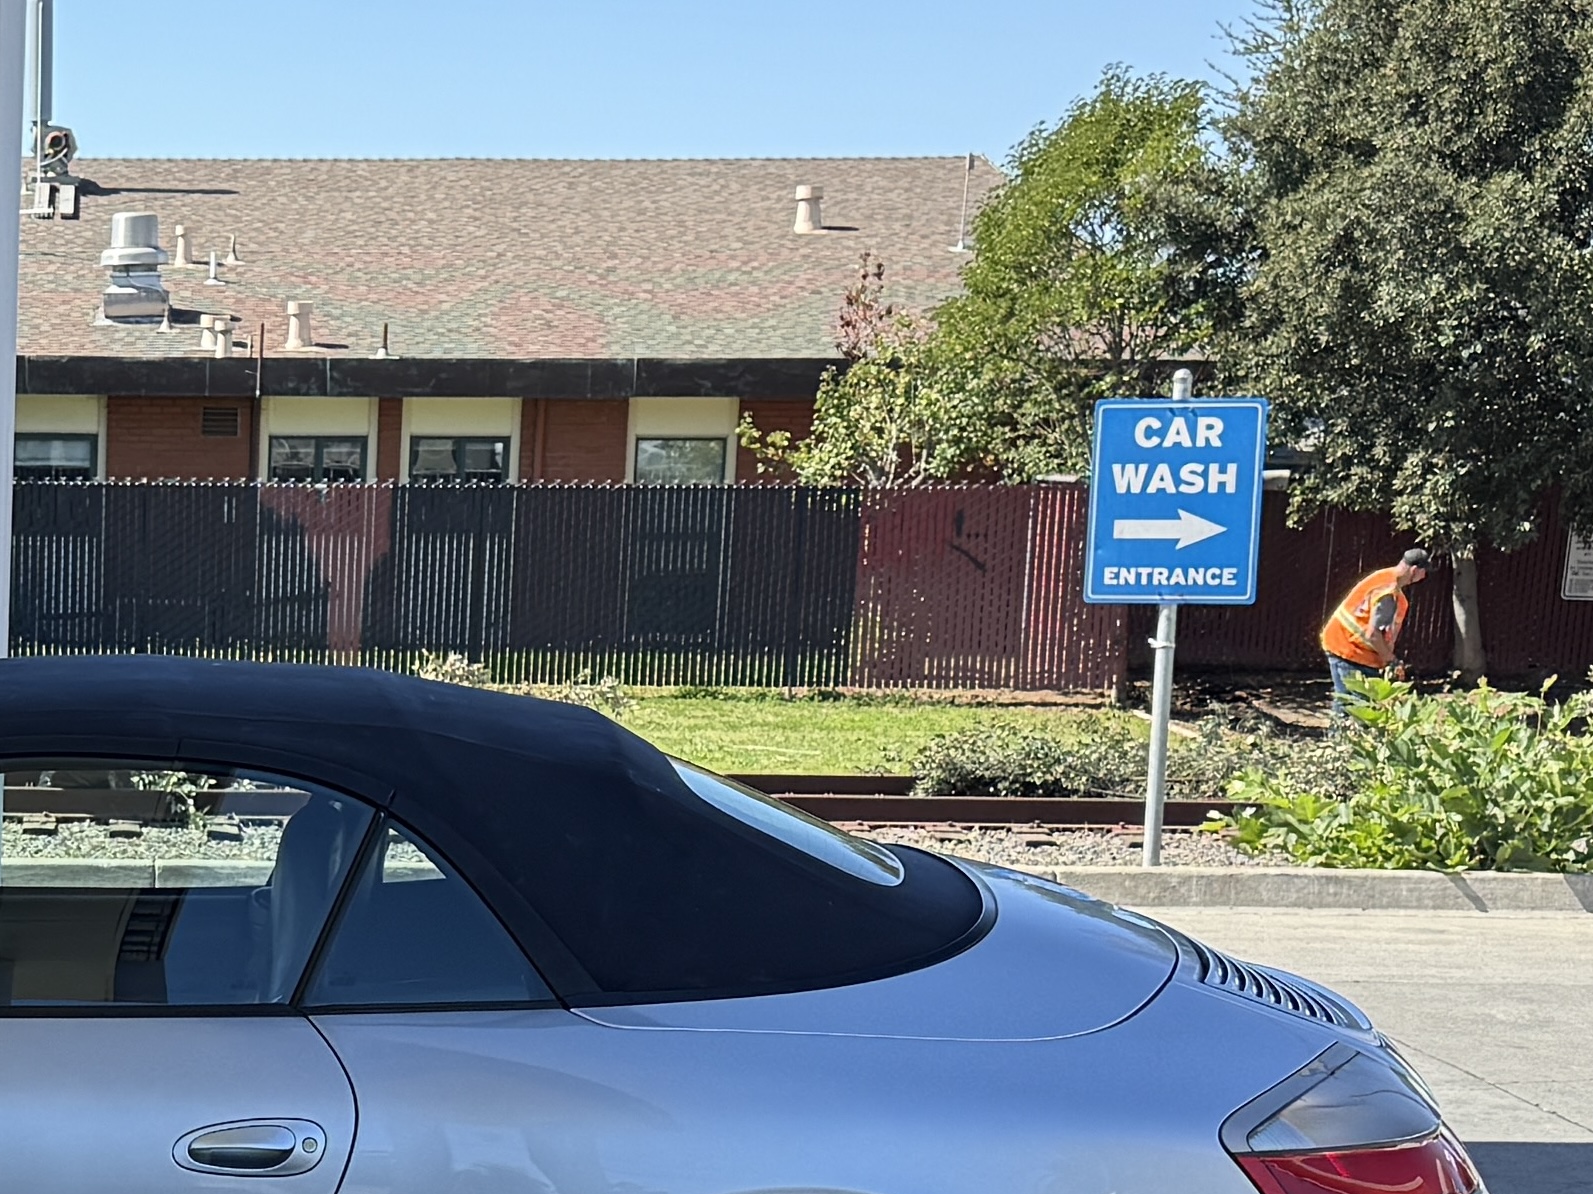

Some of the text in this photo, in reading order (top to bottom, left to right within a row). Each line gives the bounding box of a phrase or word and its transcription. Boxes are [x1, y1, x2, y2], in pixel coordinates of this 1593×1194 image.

[1134, 416, 1224, 448] CAR
[1111, 463, 1238, 494] WASH
[1103, 567, 1238, 586] ENTRANCE
